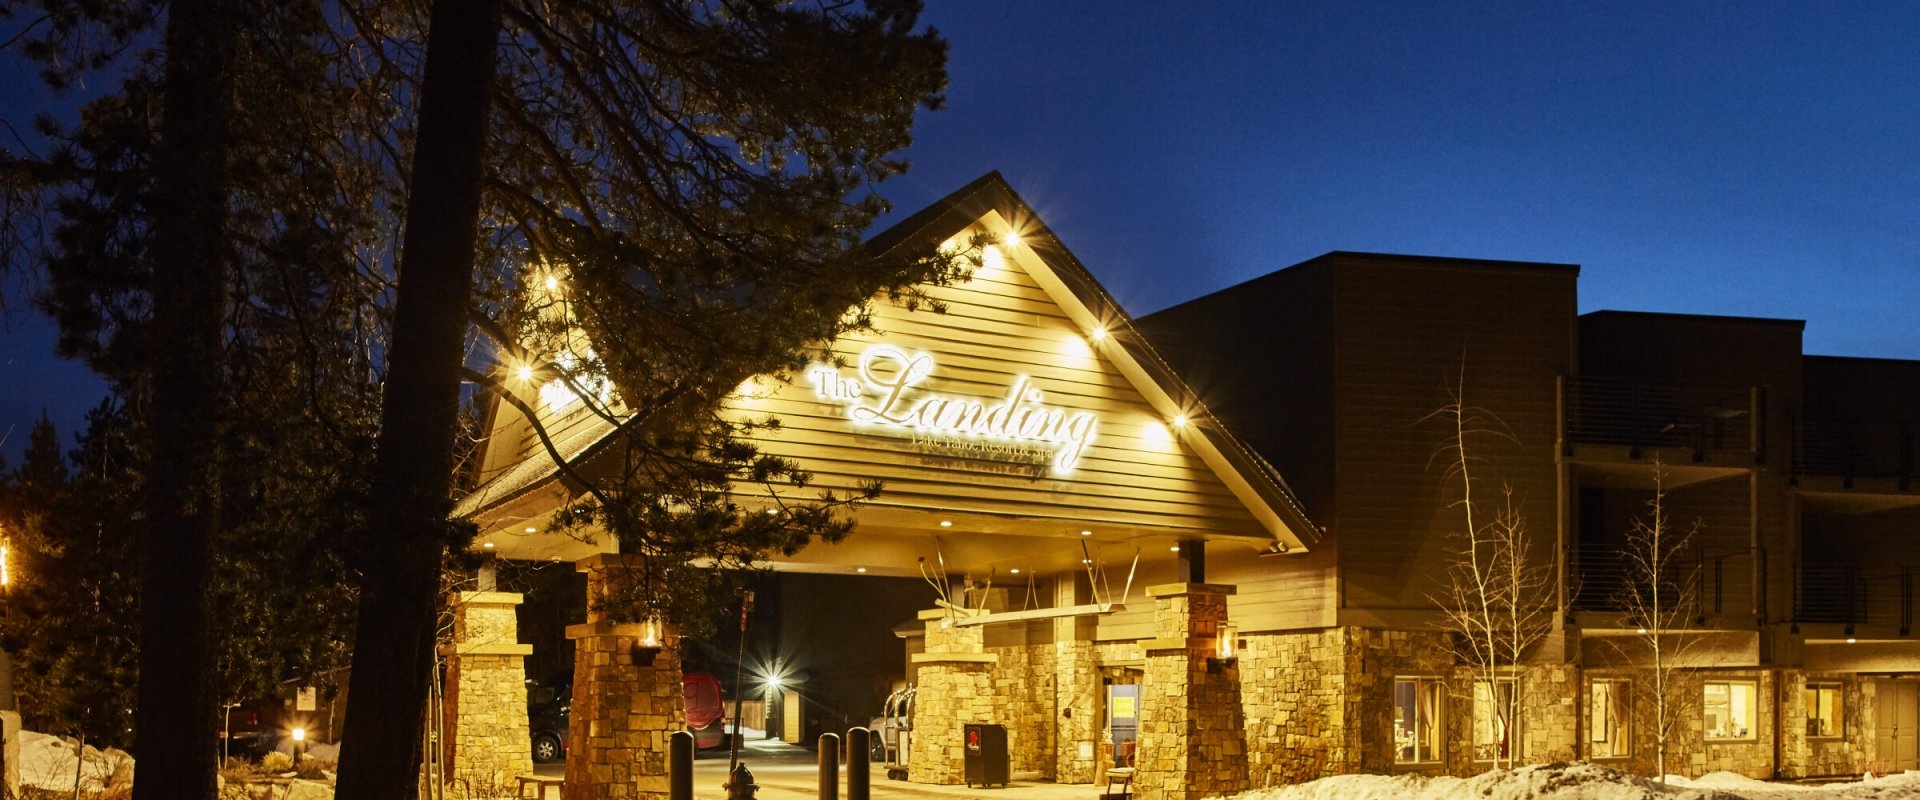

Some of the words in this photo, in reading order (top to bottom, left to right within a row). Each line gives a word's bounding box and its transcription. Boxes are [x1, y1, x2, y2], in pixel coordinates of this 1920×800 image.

[813, 368, 862, 399] The
[853, 347, 1098, 470] Landing
[912, 433, 941, 447] Lake
[944, 436, 978, 450] Tahoe
[981, 440, 1019, 455] Resort
[1020, 446, 1031, 456] &
[1033, 446, 1054, 460] Spa
